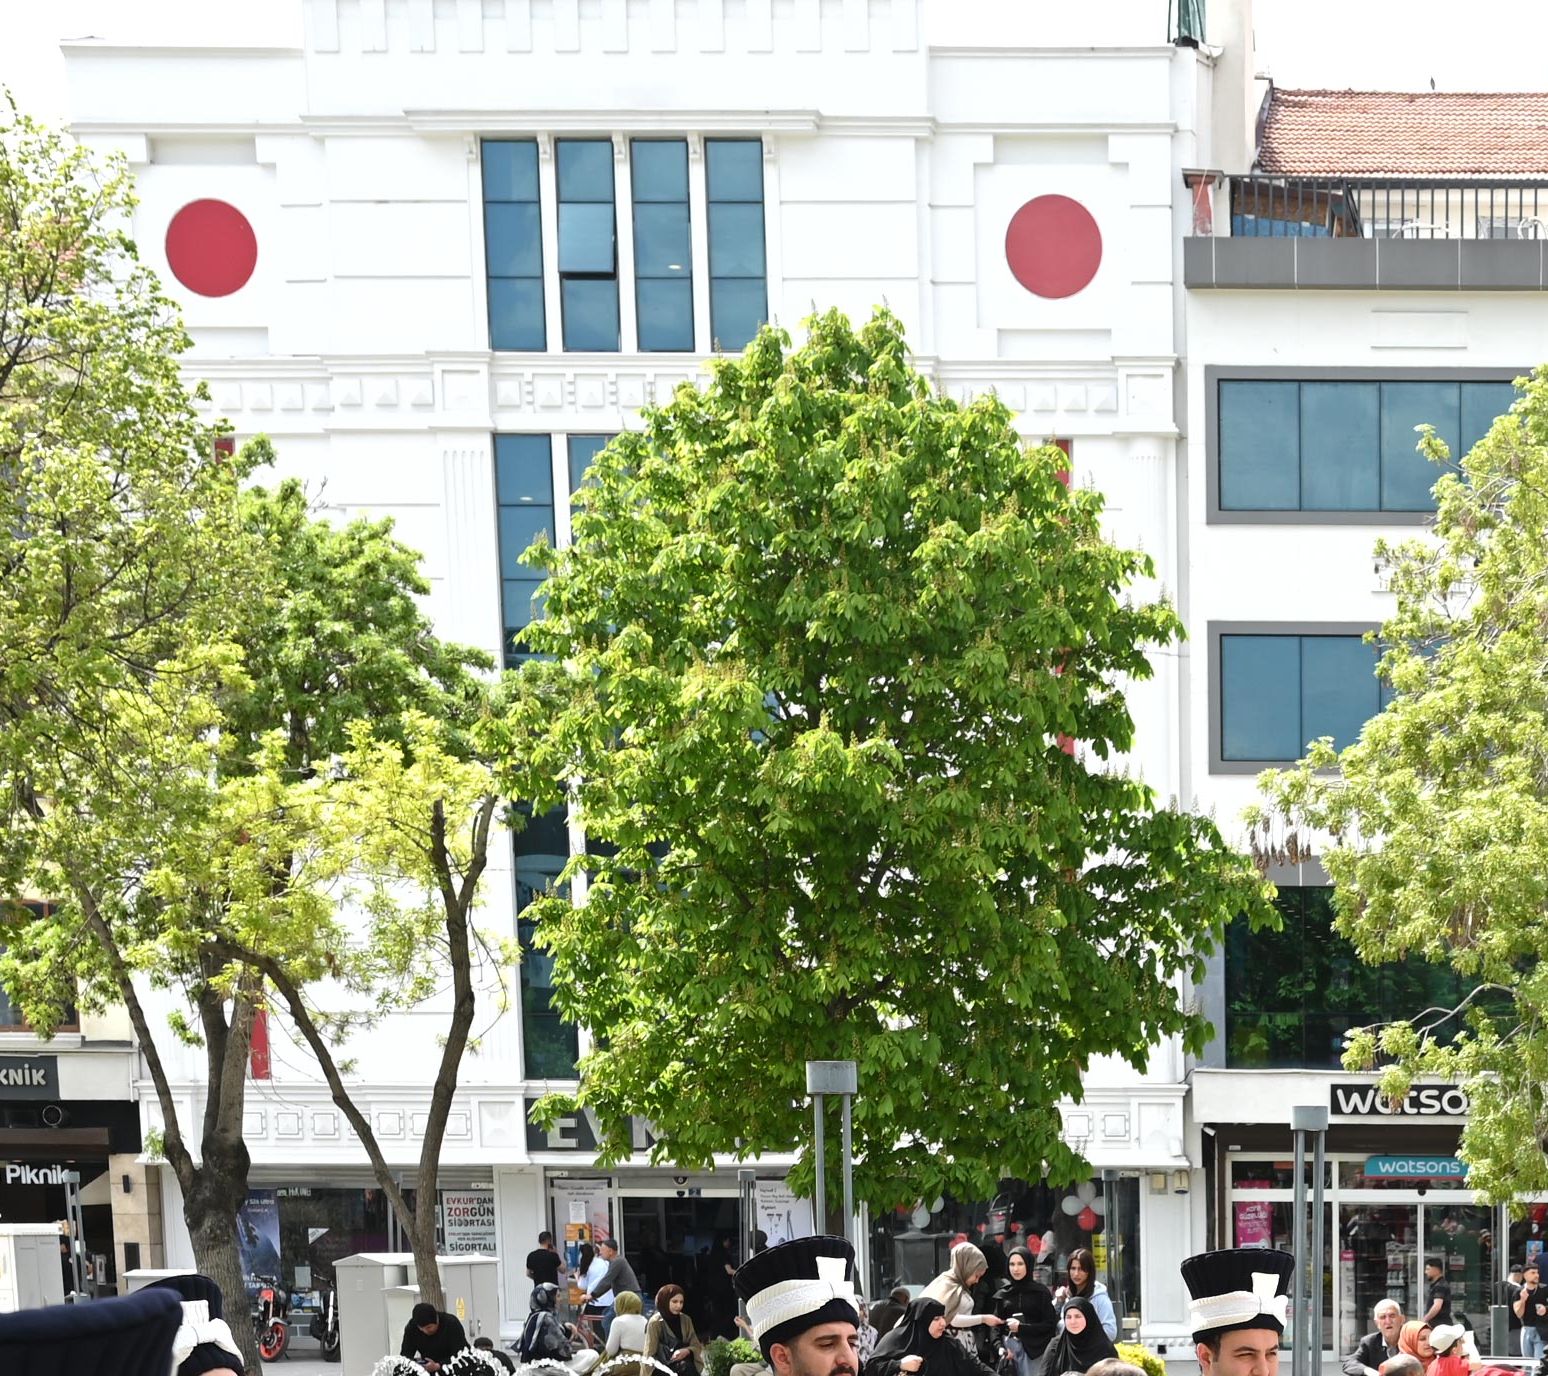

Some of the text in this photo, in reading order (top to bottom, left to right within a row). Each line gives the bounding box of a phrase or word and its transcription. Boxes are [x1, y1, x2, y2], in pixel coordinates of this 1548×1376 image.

[1378, 1159, 1461, 1174] watsons
[447, 1205, 494, 1217] ZORGÜN
[449, 1242, 496, 1252] SİGORTALI
